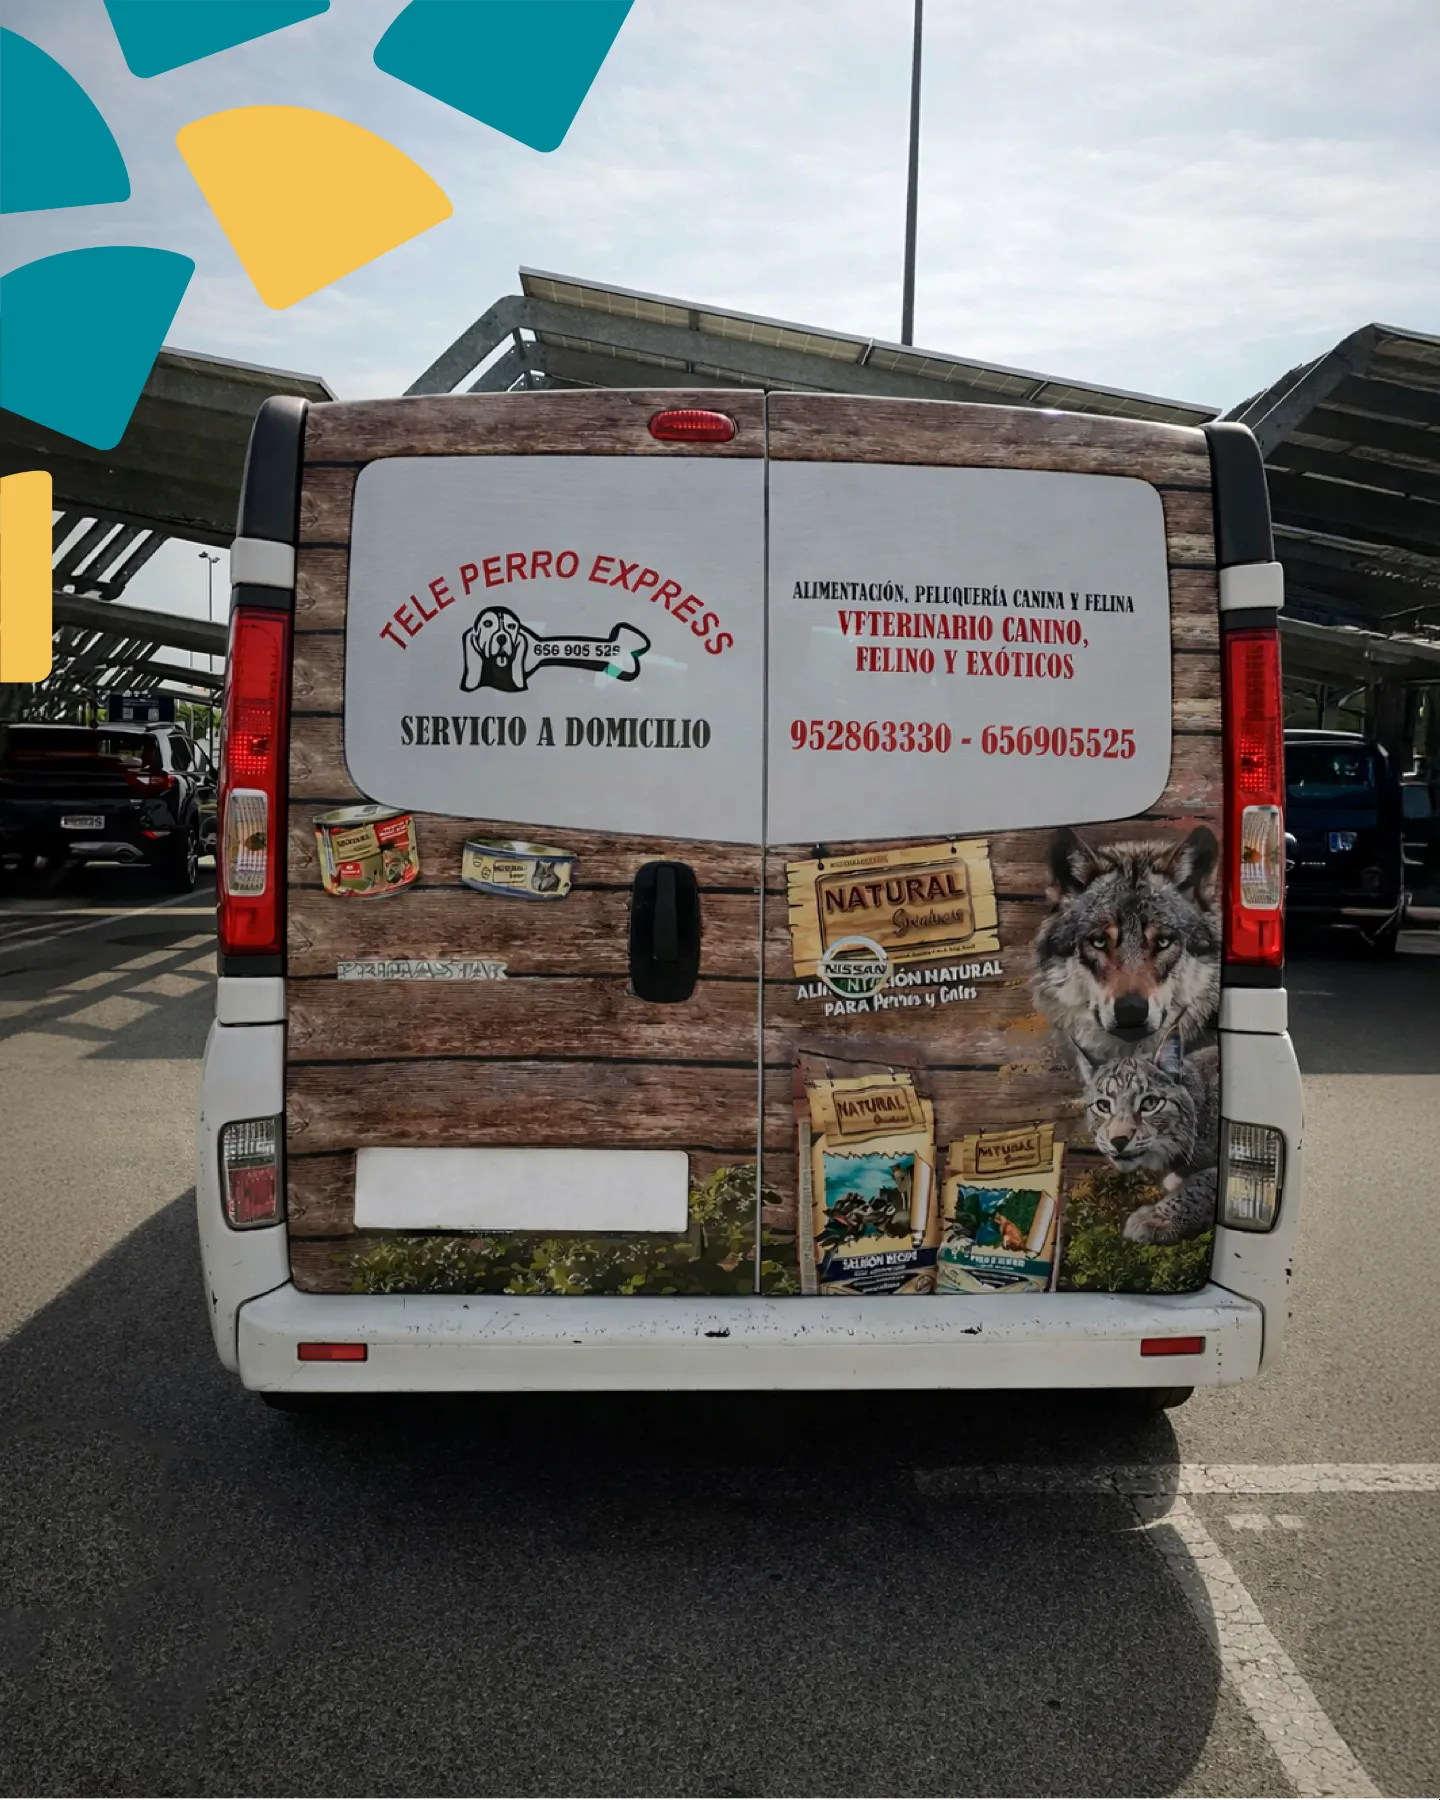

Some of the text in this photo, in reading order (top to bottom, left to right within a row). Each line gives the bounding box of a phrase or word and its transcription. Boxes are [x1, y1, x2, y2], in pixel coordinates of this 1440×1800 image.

[379, 550, 734, 655] TELE PERRO EXPRESS
[793, 580, 1135, 613] ALIMENTACIÓN, PELUQUERÍA CANINA Y FELINA
[1002, 617, 1090, 649] CANINO,
[534, 644, 560, 656] 656
[564, 644, 590, 657] 905
[856, 646, 1075, 680] FELINO Y EXÓTICOS
[400, 715, 712, 749] SERVICIO A DOMICILIO
[790, 719, 952, 754] 952863330
[981, 724, 1137, 760] 656905525
[825, 874, 967, 915] NATURAL
[824, 964, 887, 975] NISSAN
[925, 960, 1003, 984] NATURAL
[825, 999, 870, 1016] PARA
[837, 1095, 906, 1118] NATURAL
